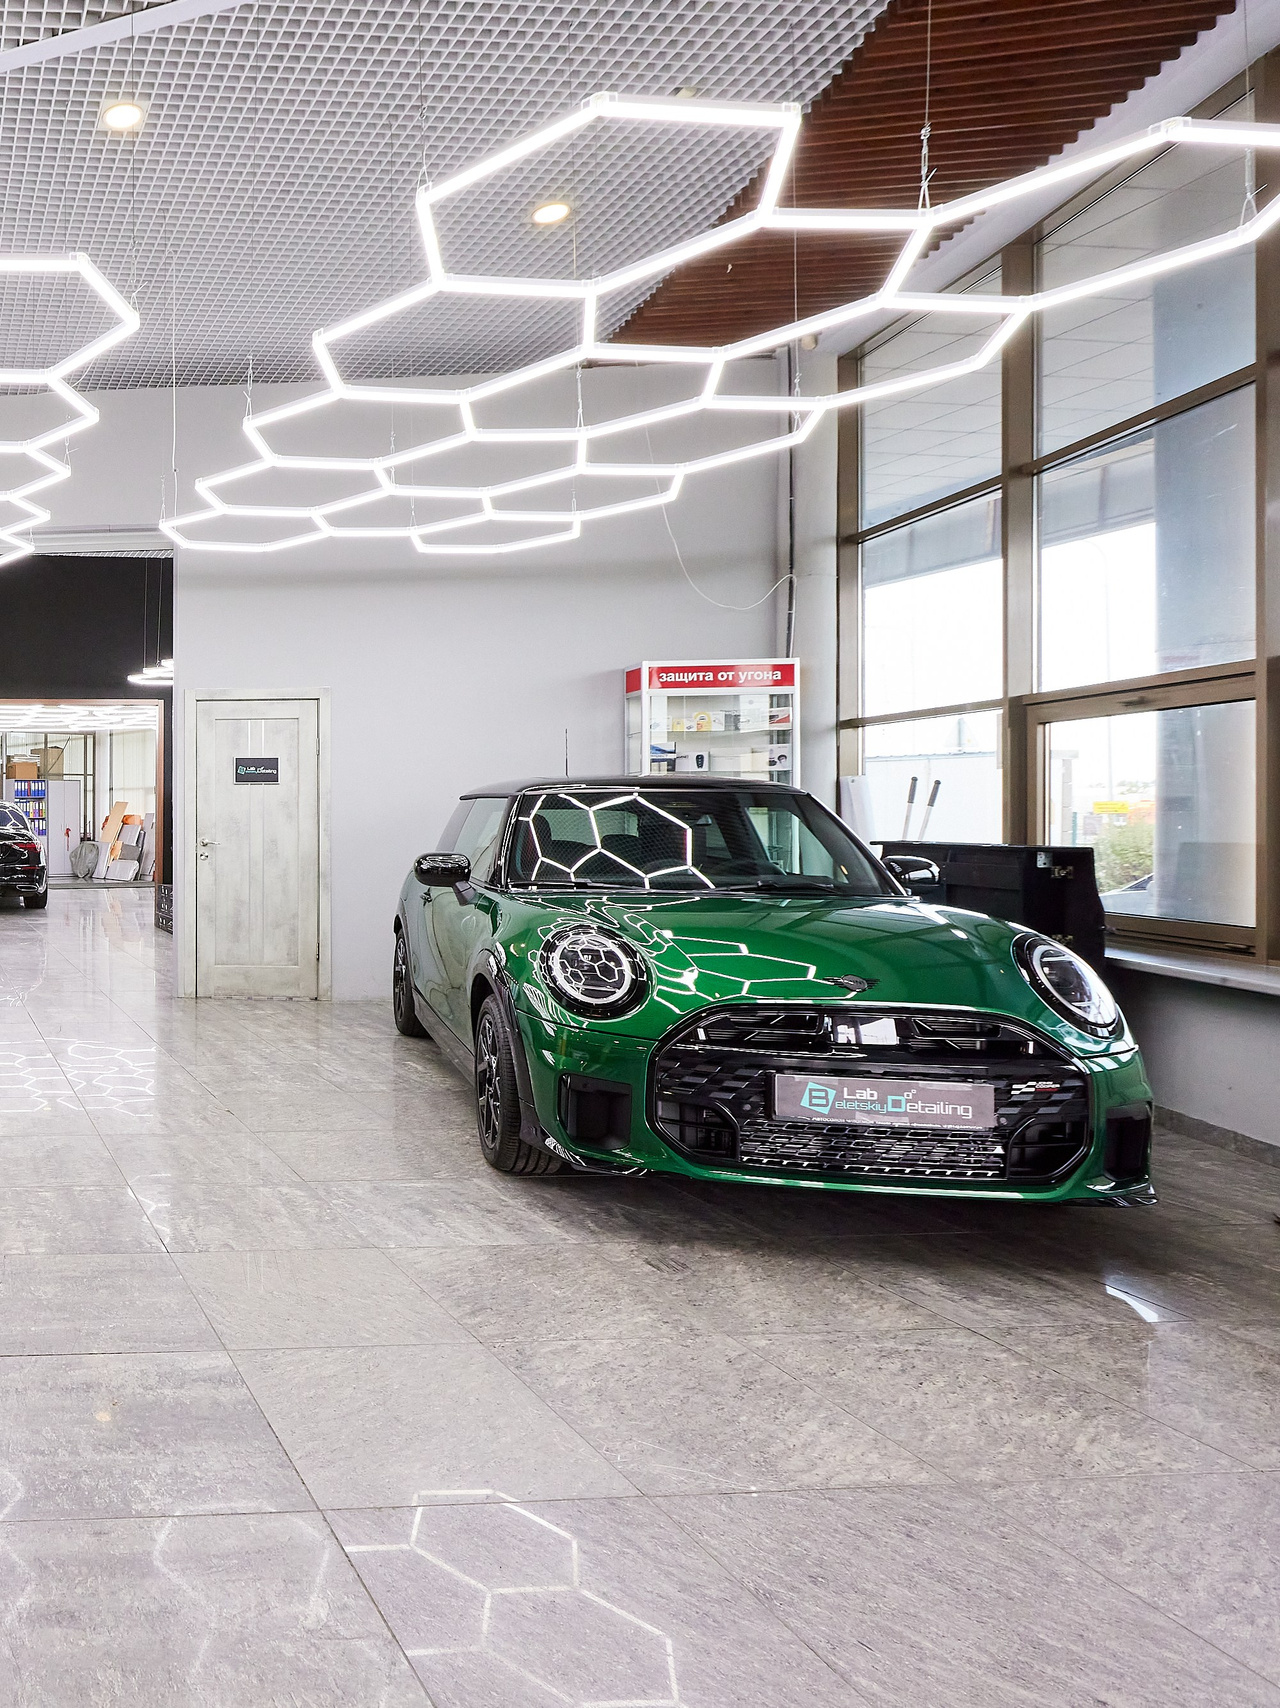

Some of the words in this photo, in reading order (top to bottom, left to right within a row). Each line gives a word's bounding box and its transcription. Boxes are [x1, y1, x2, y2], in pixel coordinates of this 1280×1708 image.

[659, 671, 714, 683] защита
[718, 671, 735, 681] от
[738, 670, 782, 683] угона
[843, 1087, 878, 1100] Lab
[887, 1094, 973, 1119] Detailing
